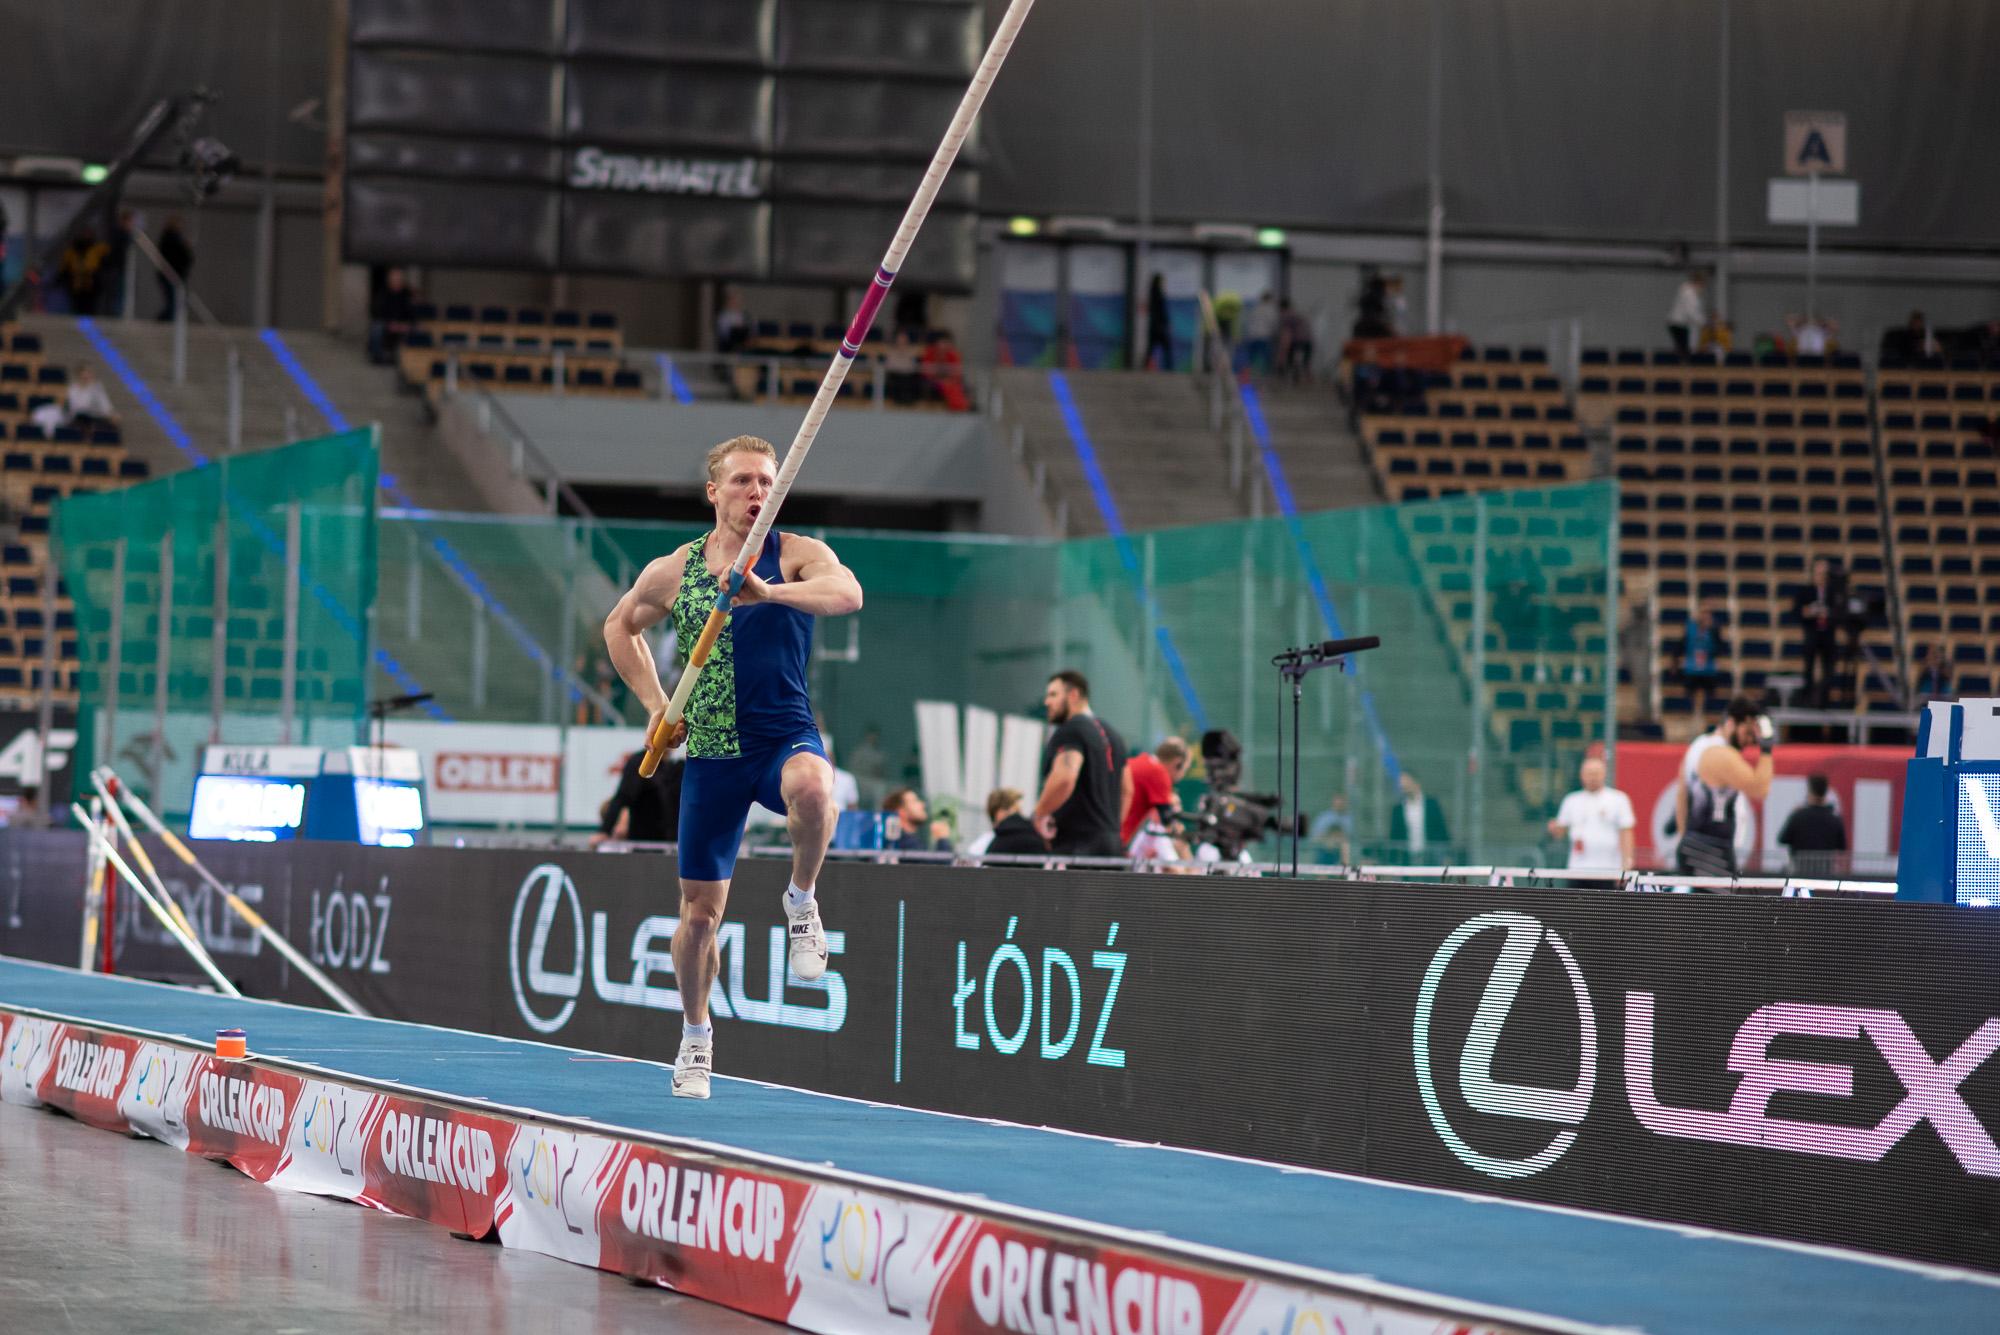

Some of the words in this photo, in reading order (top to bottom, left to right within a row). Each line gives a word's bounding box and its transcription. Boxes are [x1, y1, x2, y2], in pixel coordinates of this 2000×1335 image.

[439, 757, 555, 788] ORLEN
[310, 872, 391, 973] ŁÓDŹ
[791, 923, 809, 934] NIKE
[953, 916, 1128, 1067] ŁÓDŹ
[692, 1054, 710, 1065] NIKE
